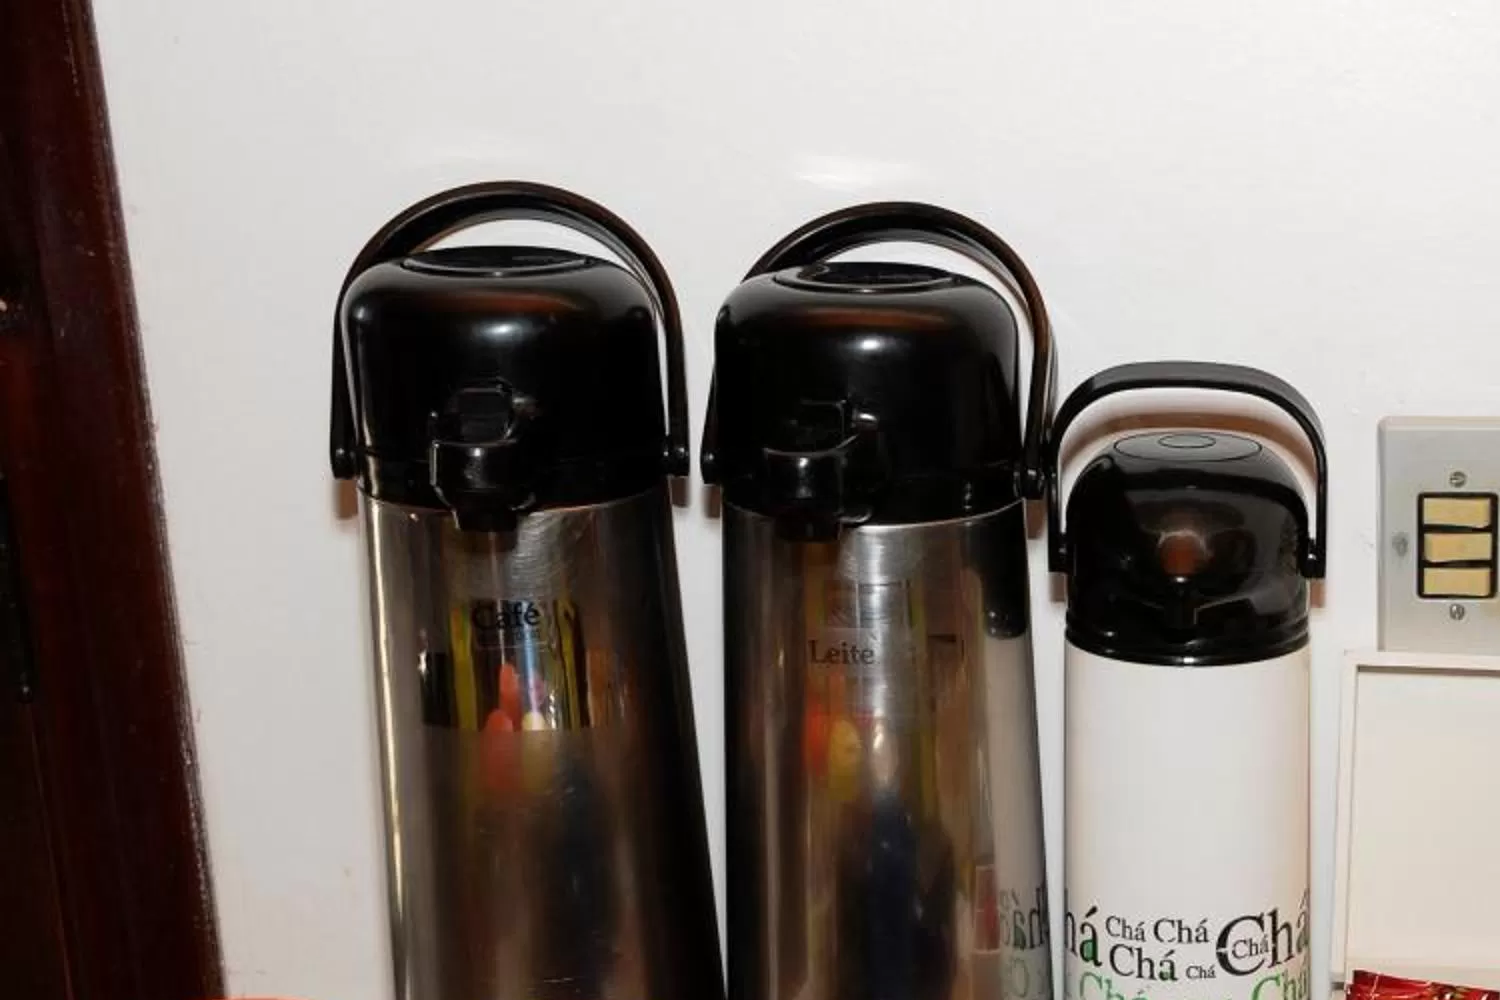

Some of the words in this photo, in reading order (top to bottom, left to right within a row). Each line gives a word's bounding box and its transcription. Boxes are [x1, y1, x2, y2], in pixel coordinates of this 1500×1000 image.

[472, 599, 541, 630] Café
[808, 639, 875, 665] Leite
[1105, 915, 1146, 943] Chá
[1153, 917, 1210, 944] Chá
[1231, 934, 1269, 960] Chá
[1109, 943, 1178, 982] Chá
[1185, 964, 1217, 980] Chá
